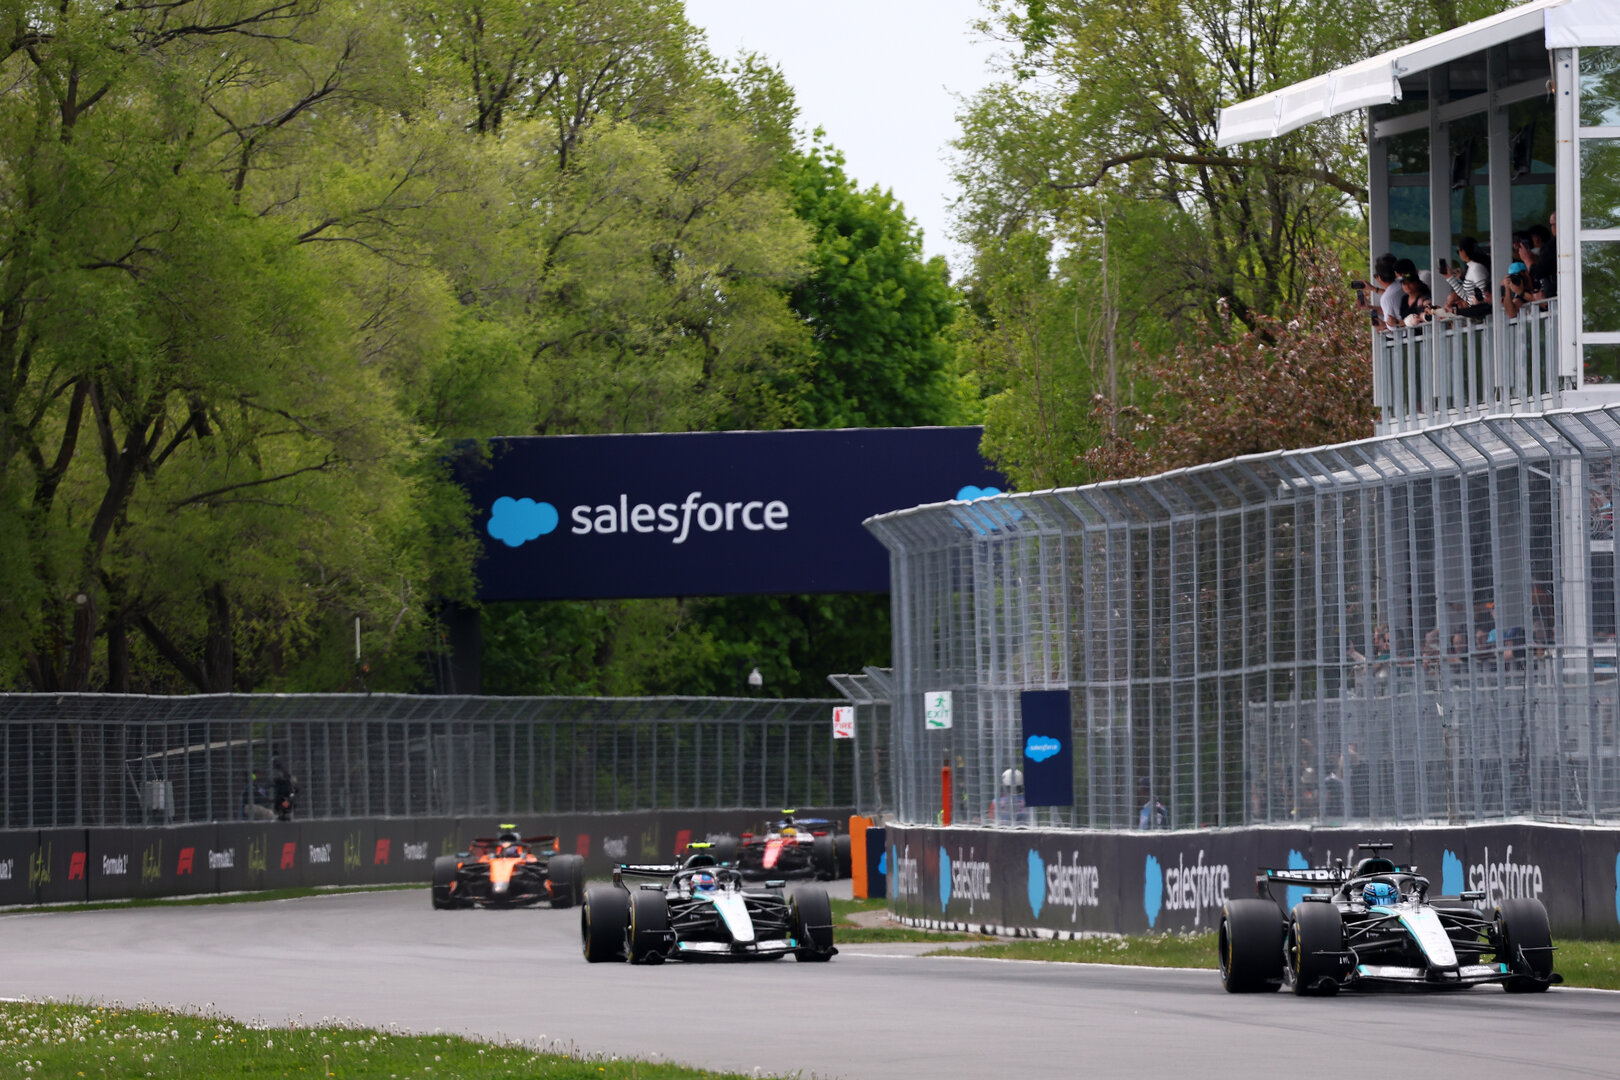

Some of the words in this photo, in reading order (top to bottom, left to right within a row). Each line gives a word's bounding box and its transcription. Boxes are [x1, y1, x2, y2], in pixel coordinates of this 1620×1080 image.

[571, 491, 790, 545] salesforce
[927, 710, 950, 718] EXIT
[1046, 850, 1099, 923] salesforce
[1166, 849, 1230, 926] salesforce
[1469, 844, 1543, 910] salesforce
